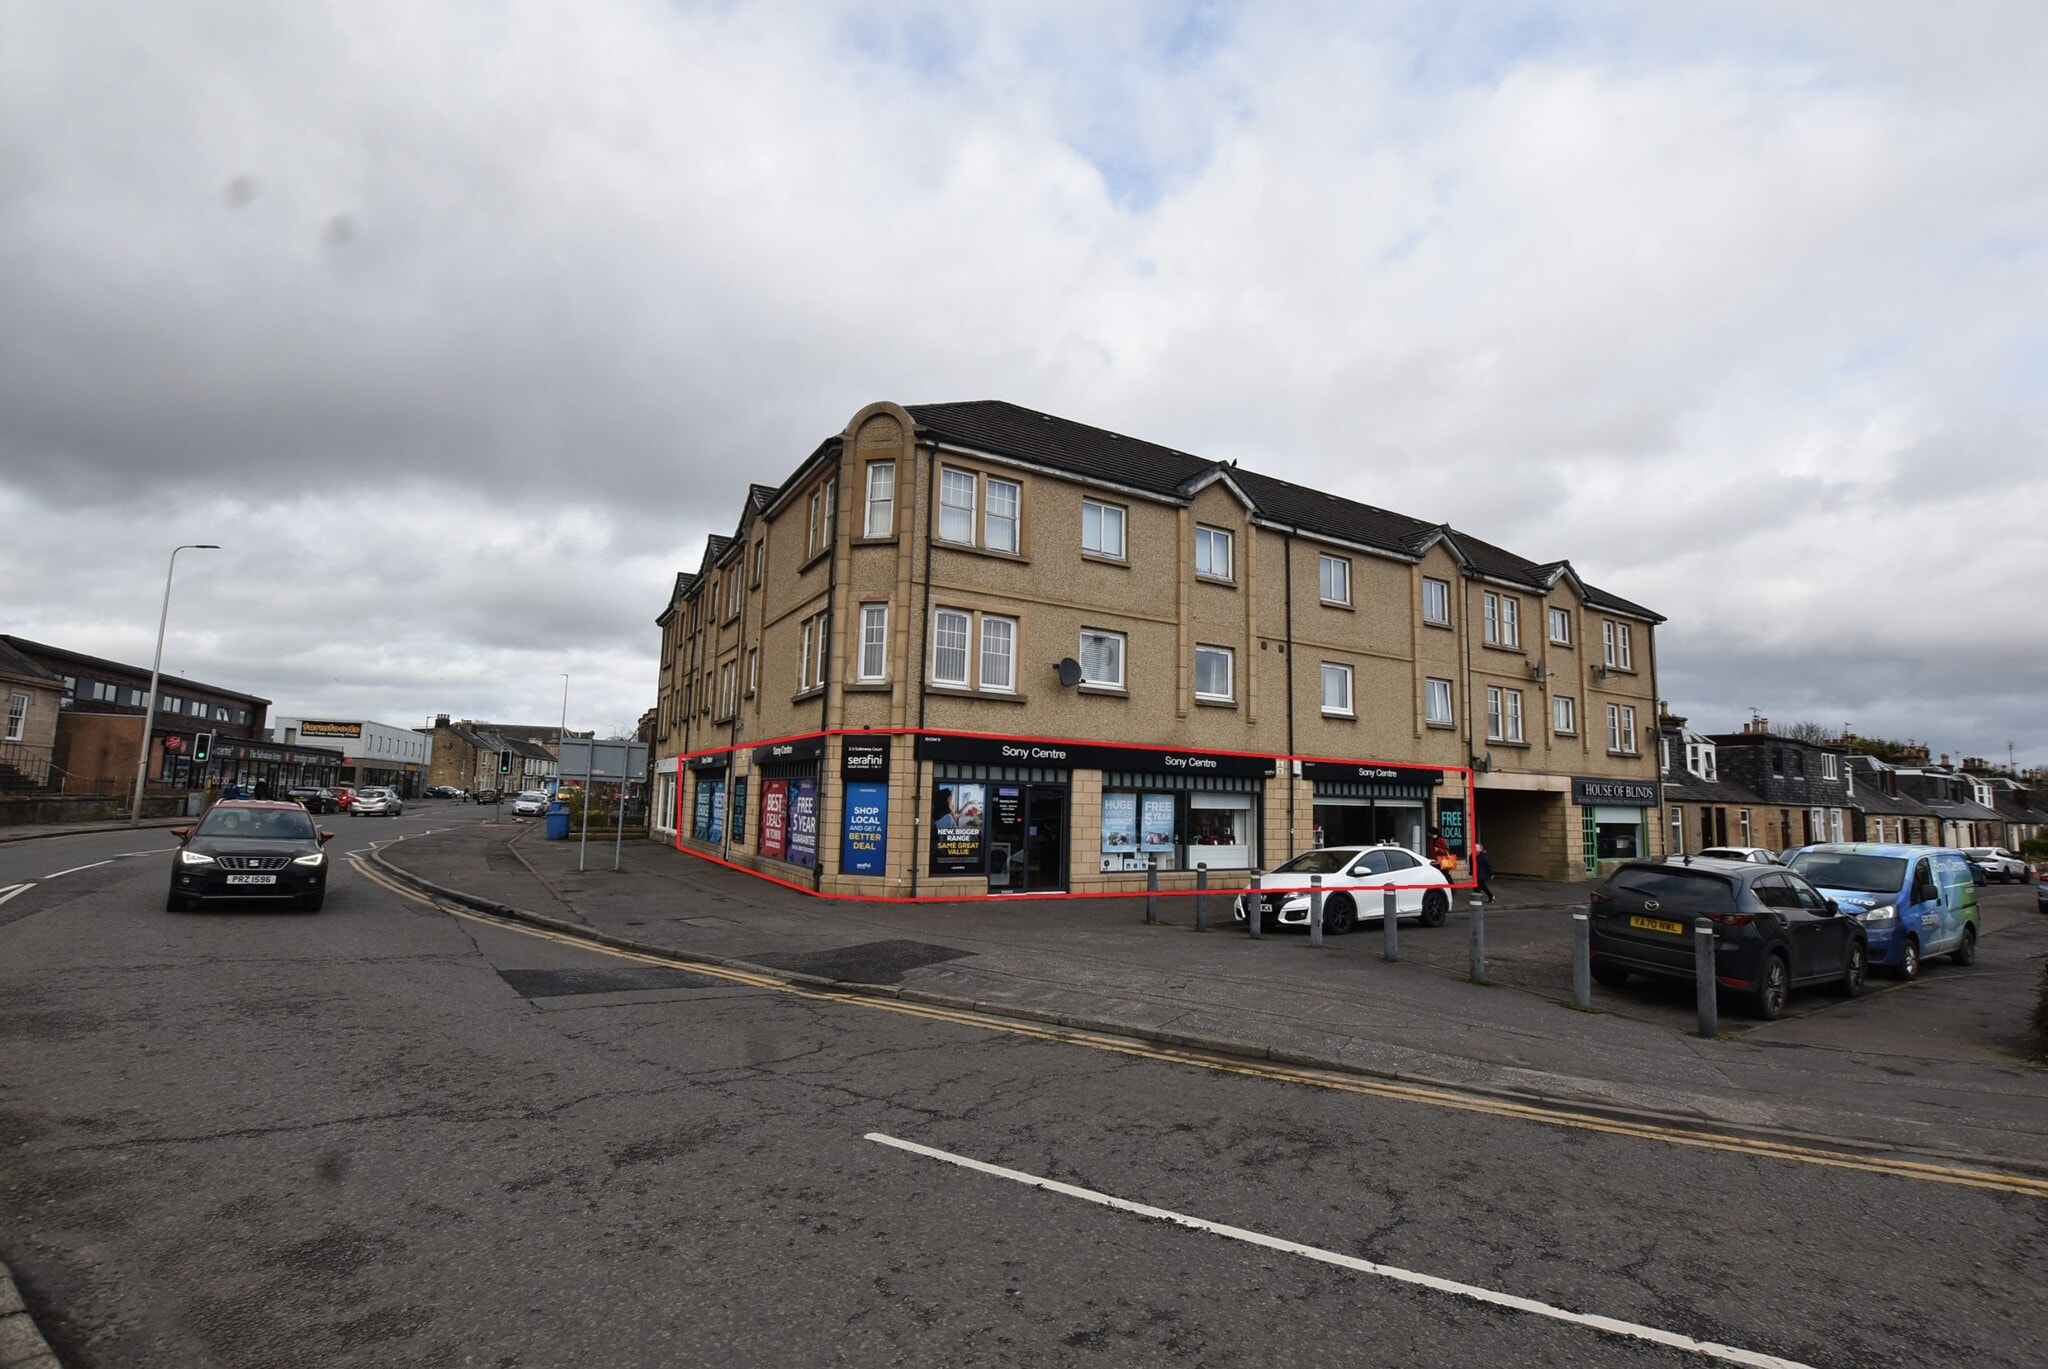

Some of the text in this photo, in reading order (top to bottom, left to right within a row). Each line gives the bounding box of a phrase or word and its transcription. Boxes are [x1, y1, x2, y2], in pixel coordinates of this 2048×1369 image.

[303, 723, 359, 734] farmfoods
[1002, 745, 1067, 759] Sony Centre
[847, 754, 883, 765] serafini
[1165, 756, 1217, 768] Sony Centre
[1358, 768, 1398, 778] Sony Centre
[1585, 783, 1653, 799] HOUSE OF BLINDS
[767, 793, 783, 812] BEST
[797, 797, 813, 814] FREE
[1105, 800, 1133, 810] HUGE
[1145, 801, 1172, 812] FREE
[854, 806, 879, 815] SHOP
[1105, 810, 1133, 818] WINTER
[766, 813, 782, 828] DEALS
[793, 813, 816, 834] 5 YEAR
[851, 815, 880, 824] LOCAL
[1145, 813, 1153, 825] 5
[1441, 811, 1462, 826] FREE
[848, 832, 881, 841] BETTER
[1442, 827, 1462, 838] LOCAL
[853, 842, 876, 850] DEAL
[232, 875, 250, 883] PRZ
